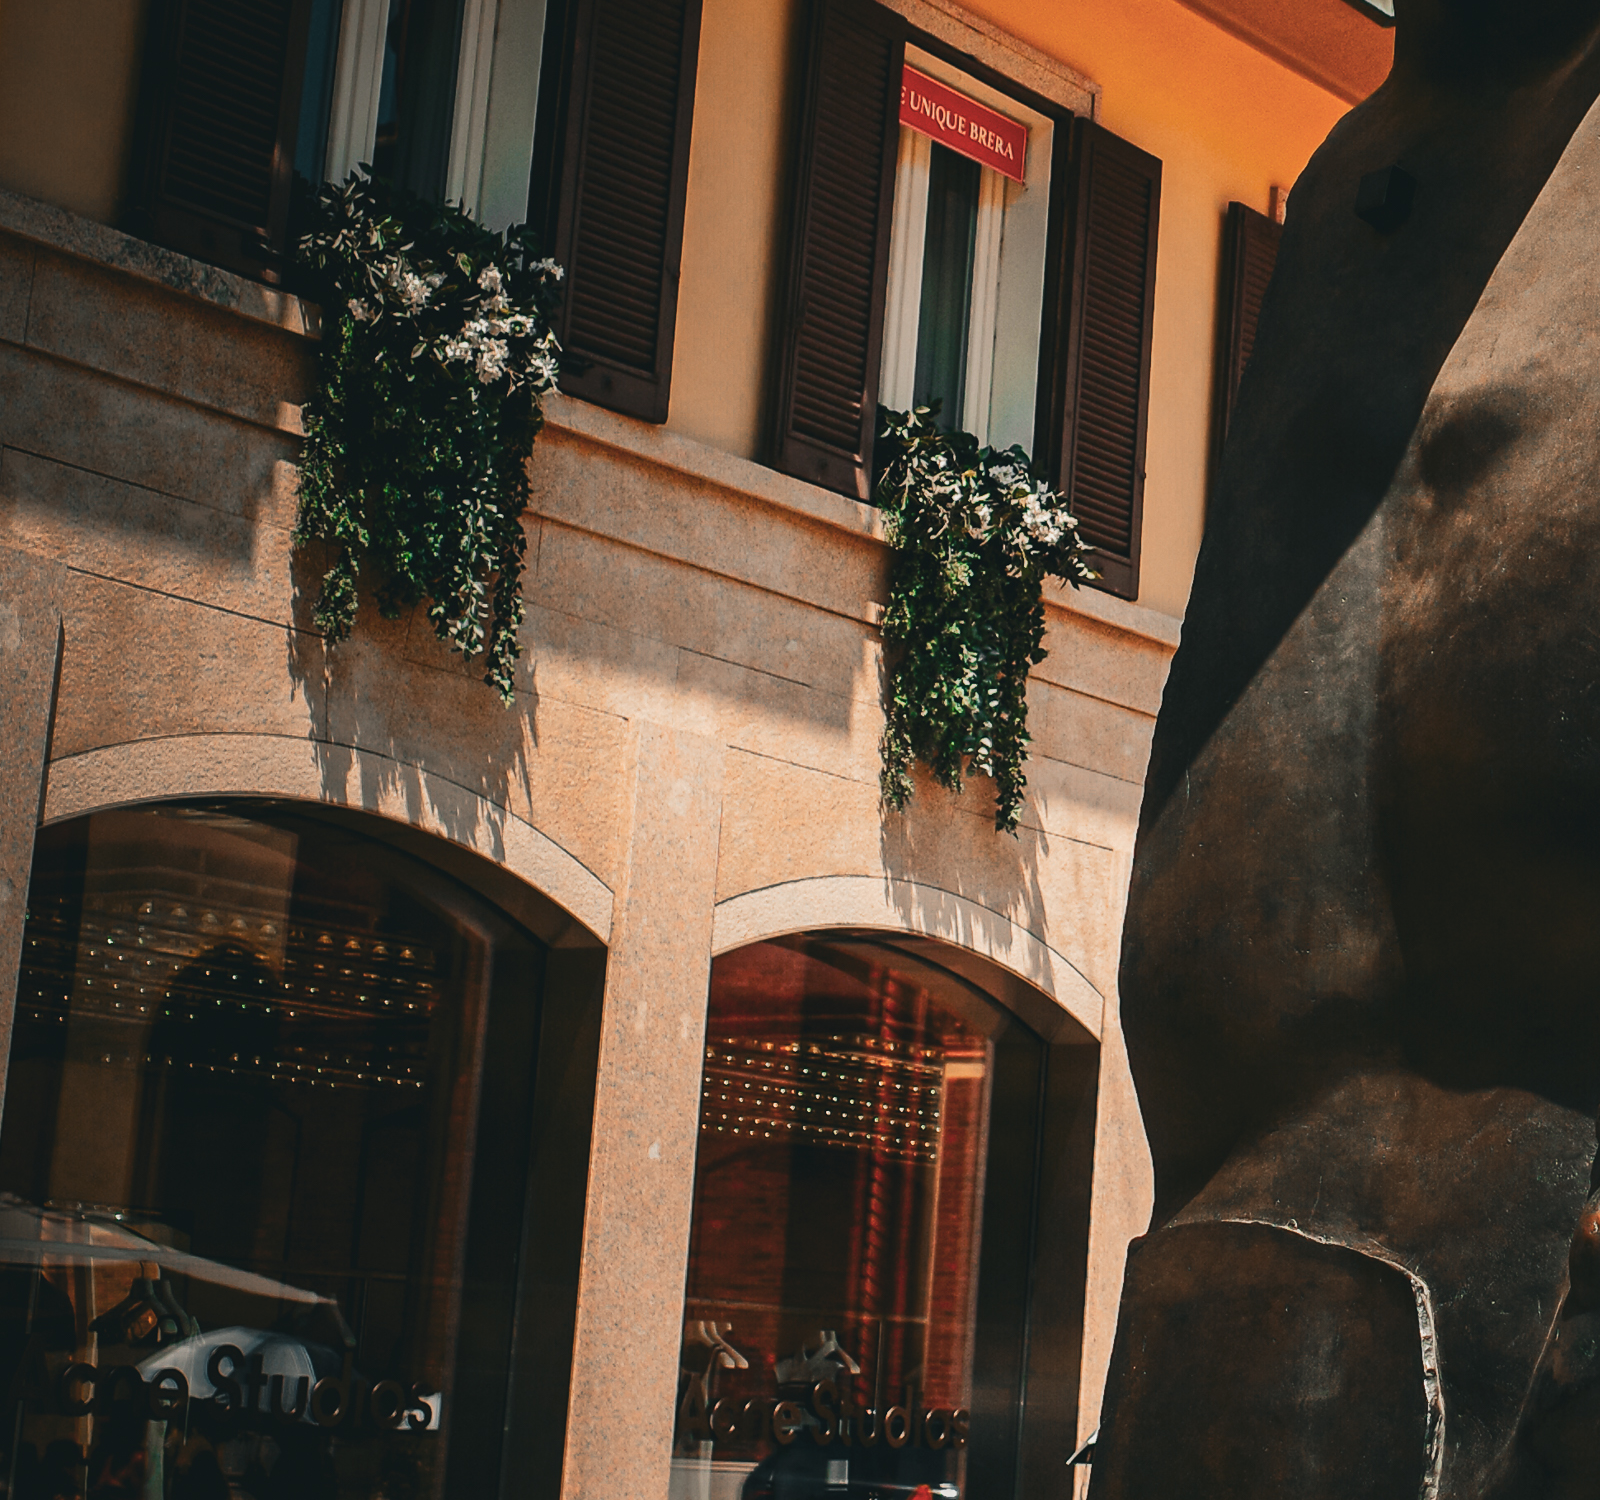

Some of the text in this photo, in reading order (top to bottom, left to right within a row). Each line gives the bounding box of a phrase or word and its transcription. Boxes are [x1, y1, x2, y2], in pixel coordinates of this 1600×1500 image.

[910, 90, 967, 136] UNIQUE
[969, 121, 1014, 161] BRERA
[206, 1343, 432, 1431] Studios
[676, 1372, 970, 1450] Acne Studios
